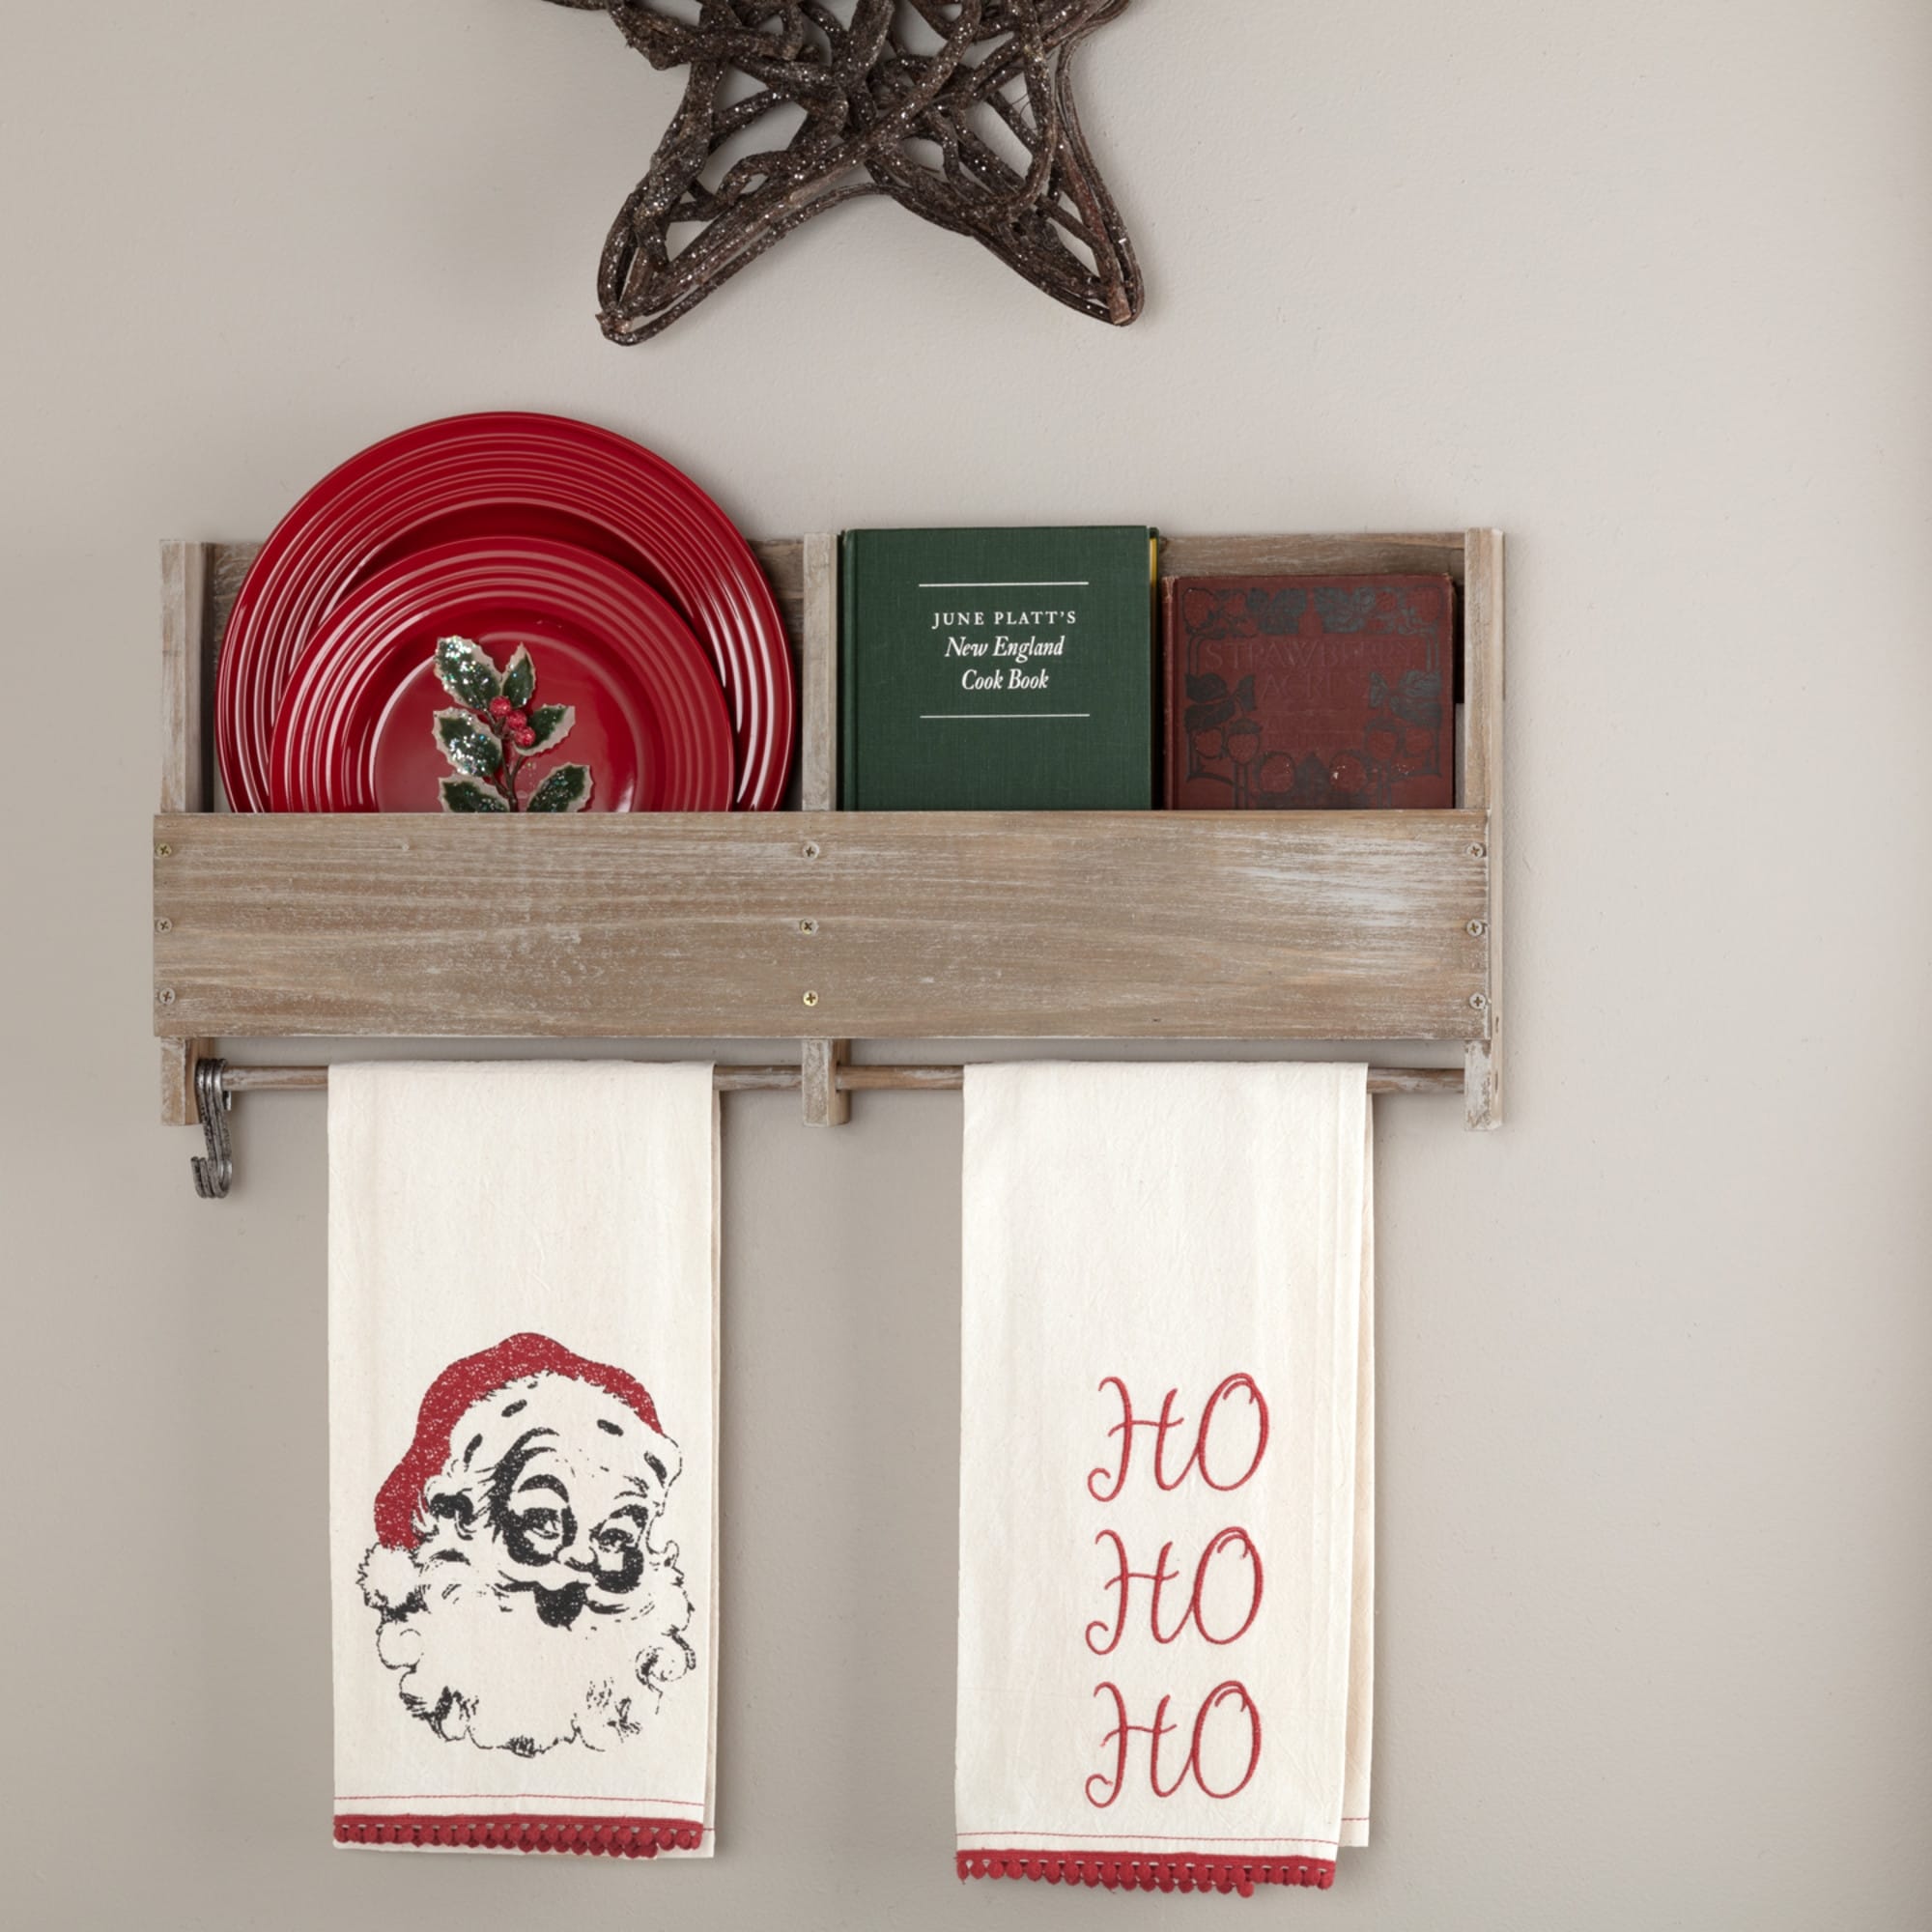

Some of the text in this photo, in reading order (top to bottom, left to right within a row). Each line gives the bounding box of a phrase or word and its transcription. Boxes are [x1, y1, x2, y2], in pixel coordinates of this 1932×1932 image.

[931, 611, 1076, 629] JUNE PLATT'S
[945, 636, 1065, 664] New England
[961, 668, 1049, 690] Cook Book
[1088, 1373, 1269, 1502] HO
[1085, 1526, 1264, 1655] HO
[1085, 1680, 1262, 1808] HO
